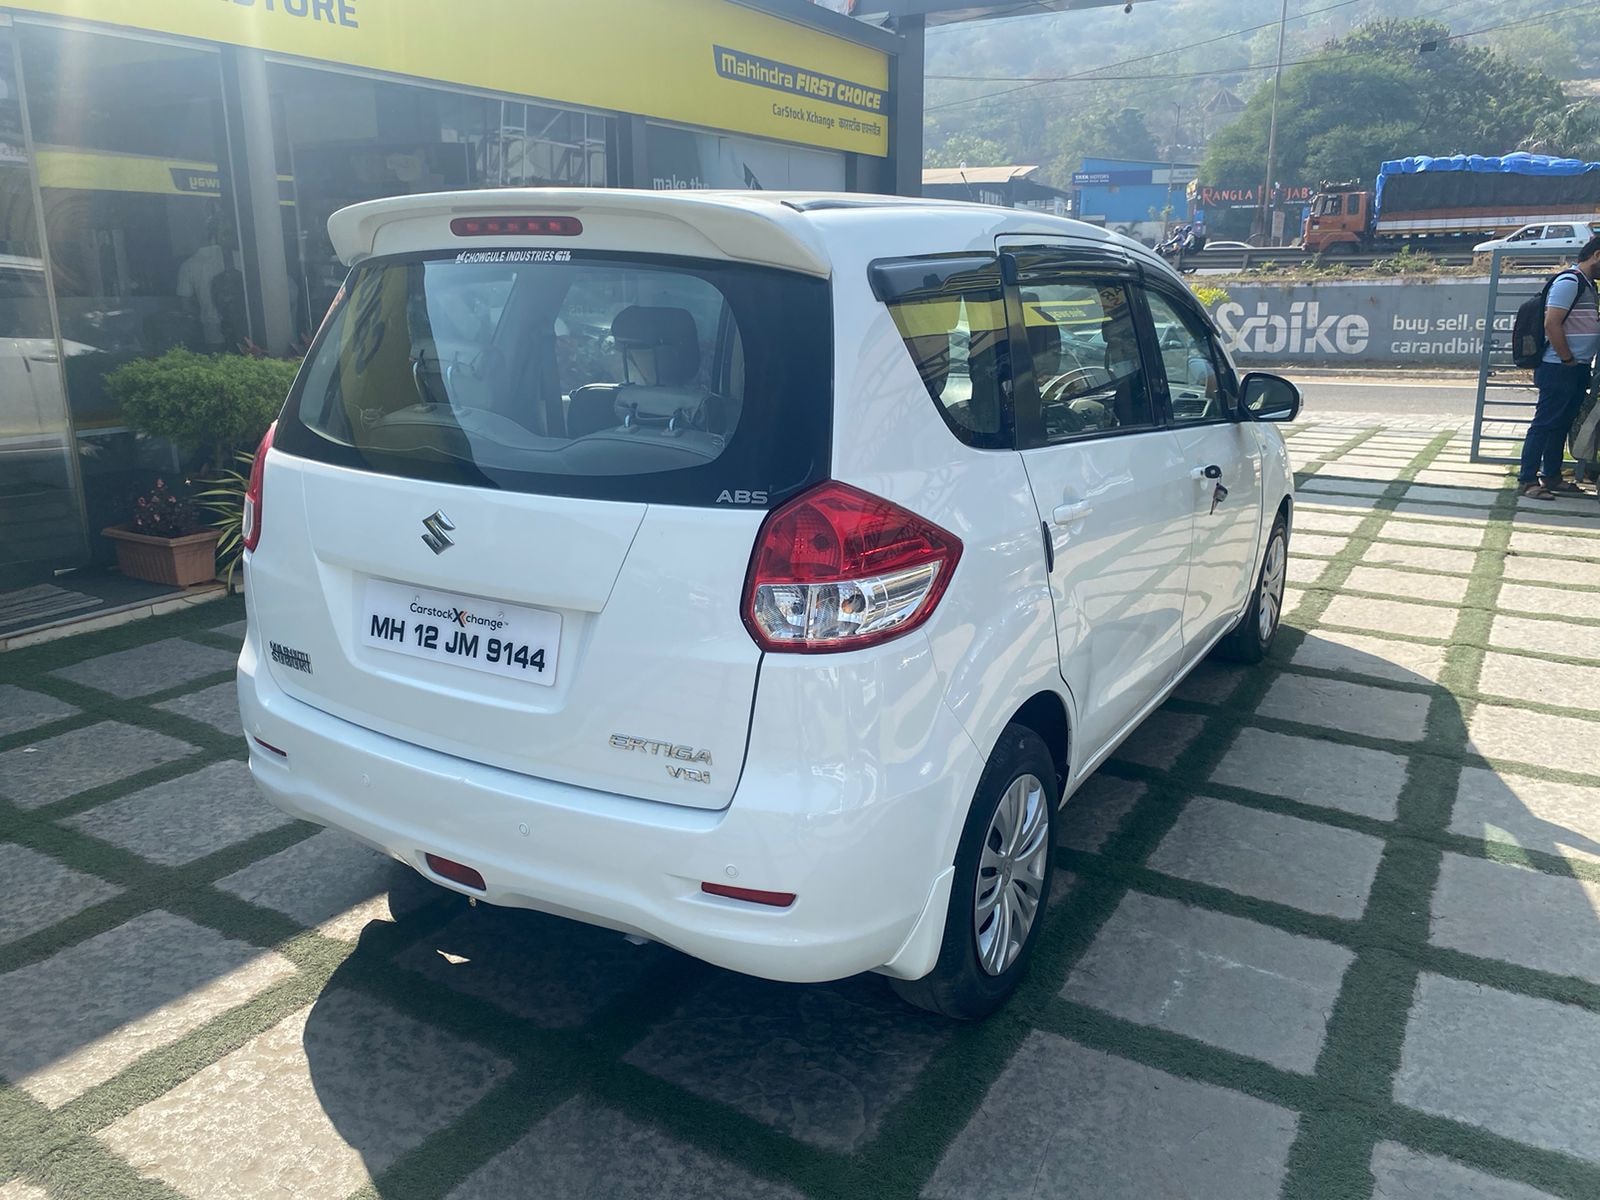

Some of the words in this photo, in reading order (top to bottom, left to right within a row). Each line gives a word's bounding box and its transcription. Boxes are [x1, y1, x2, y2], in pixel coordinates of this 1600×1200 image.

[232, 0, 359, 29] ORE
[721, 53, 793, 88] Mahindra
[796, 73, 836, 98] FIRST
[837, 85, 881, 110] CHOICE
[772, 103, 805, 122] CarStock
[806, 110, 835, 130] Xchange
[653, 174, 687, 190] make
[1201, 186, 1253, 207] RANGLA
[1258, 184, 1309, 201] JAB
[464, 251, 506, 264] CHOWGULE
[506, 250, 555, 262] INDUSTRIES
[1210, 300, 1370, 354] &bike
[716, 489, 768, 504] ABS
[370, 614, 405, 643] MH
[414, 623, 439, 649] 12
[445, 631, 479, 658] JM
[486, 638, 545, 672] 9144
[608, 734, 713, 766] ERTIGA
